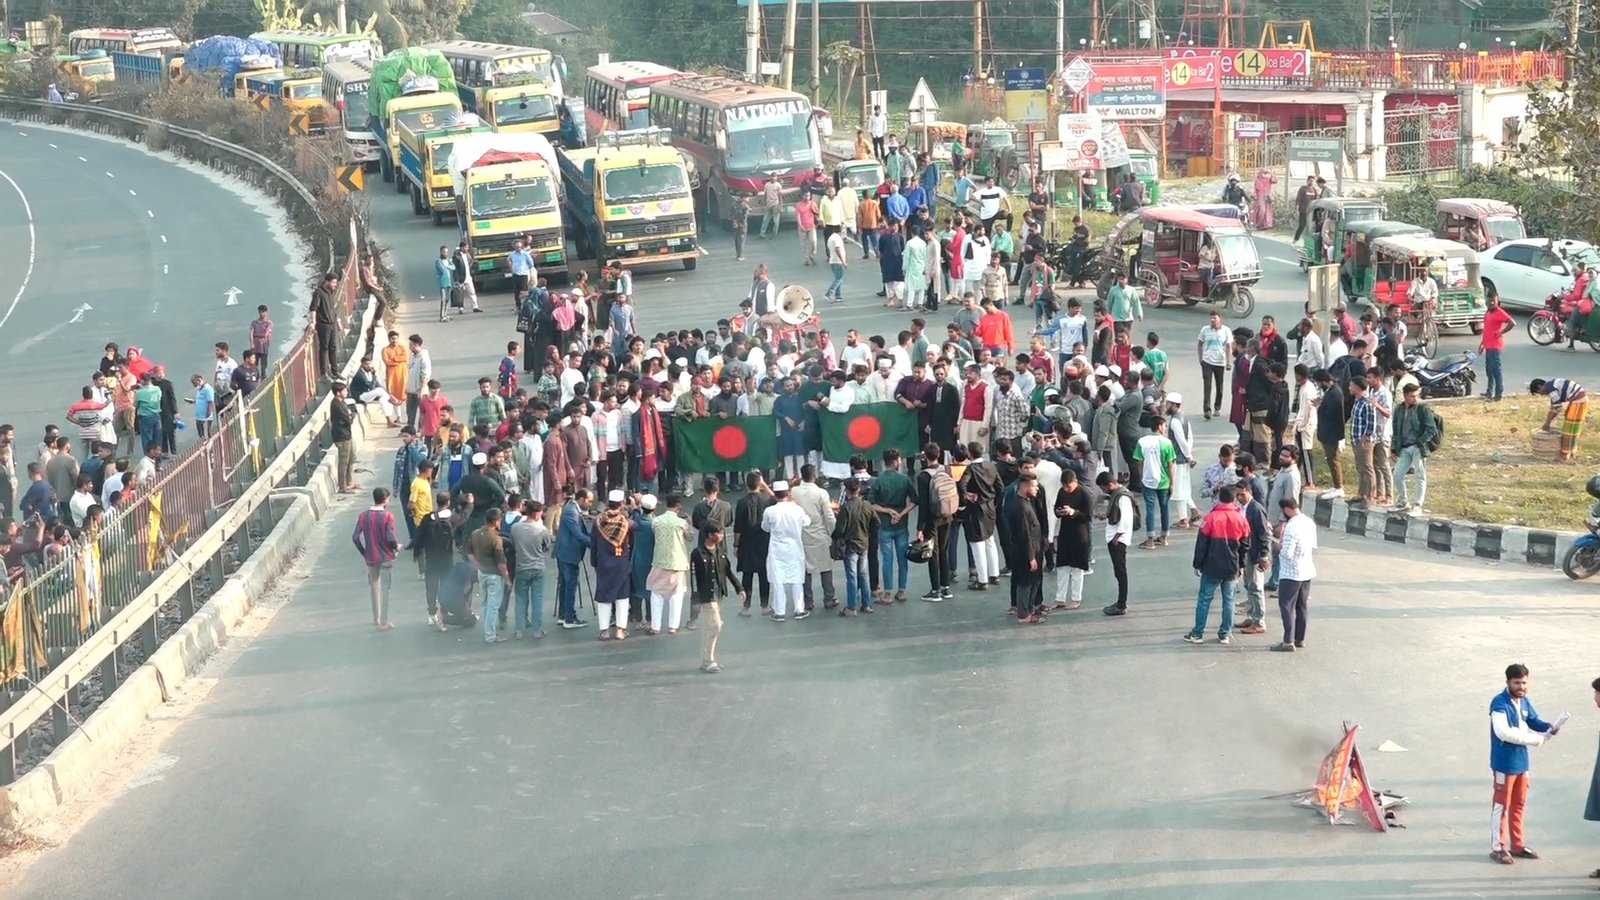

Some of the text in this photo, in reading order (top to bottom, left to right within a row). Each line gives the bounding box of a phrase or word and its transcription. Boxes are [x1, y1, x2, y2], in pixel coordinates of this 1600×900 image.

[1173, 65, 1187, 82] 14
[1206, 62, 1214, 82] 2
[1237, 52, 1261, 73] 14
[1279, 56, 1293, 68] Bar
[1292, 52, 1304, 75] 2
[725, 100, 809, 121] NATIONAL
